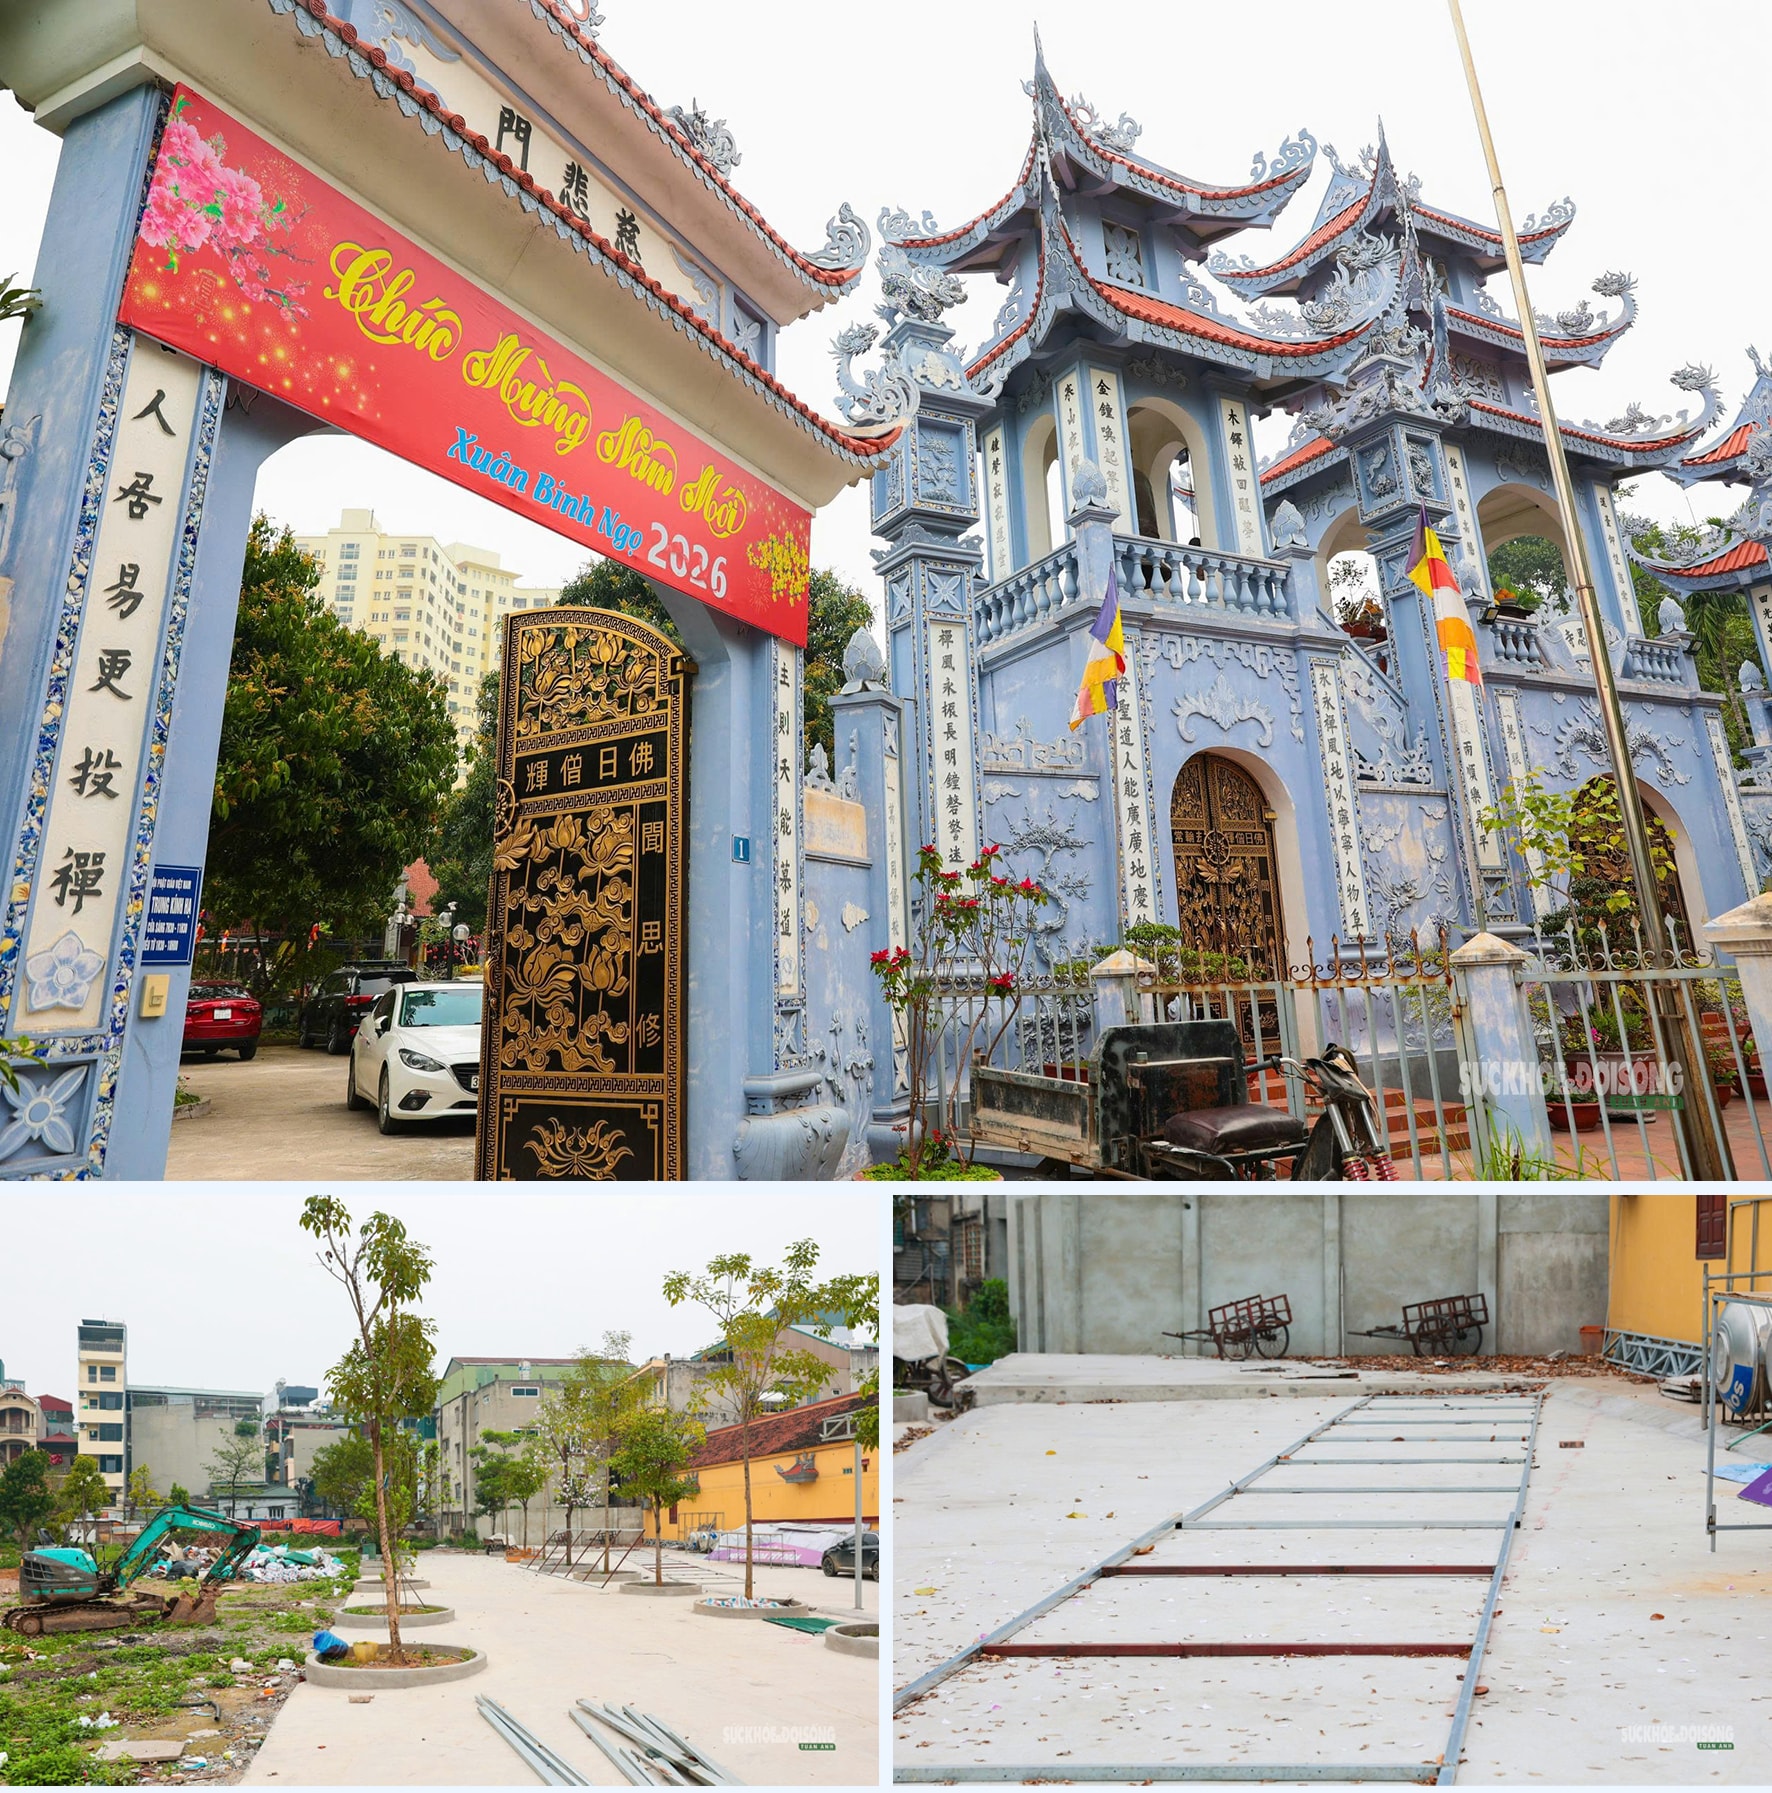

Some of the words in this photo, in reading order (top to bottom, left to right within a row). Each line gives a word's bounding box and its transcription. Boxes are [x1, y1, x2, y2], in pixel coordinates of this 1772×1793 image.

[323, 241, 464, 362] Chúc
[462, 330, 593, 456] Mừng
[596, 412, 679, 497] Năm
[679, 463, 748, 539] Mới
[448, 426, 530, 493] Xuân
[597, 506, 644, 557] Ngọ
[647, 521, 728, 599] 2026
[737, 839, 745, 859] 1
[151, 896, 170, 914] TRUNG
